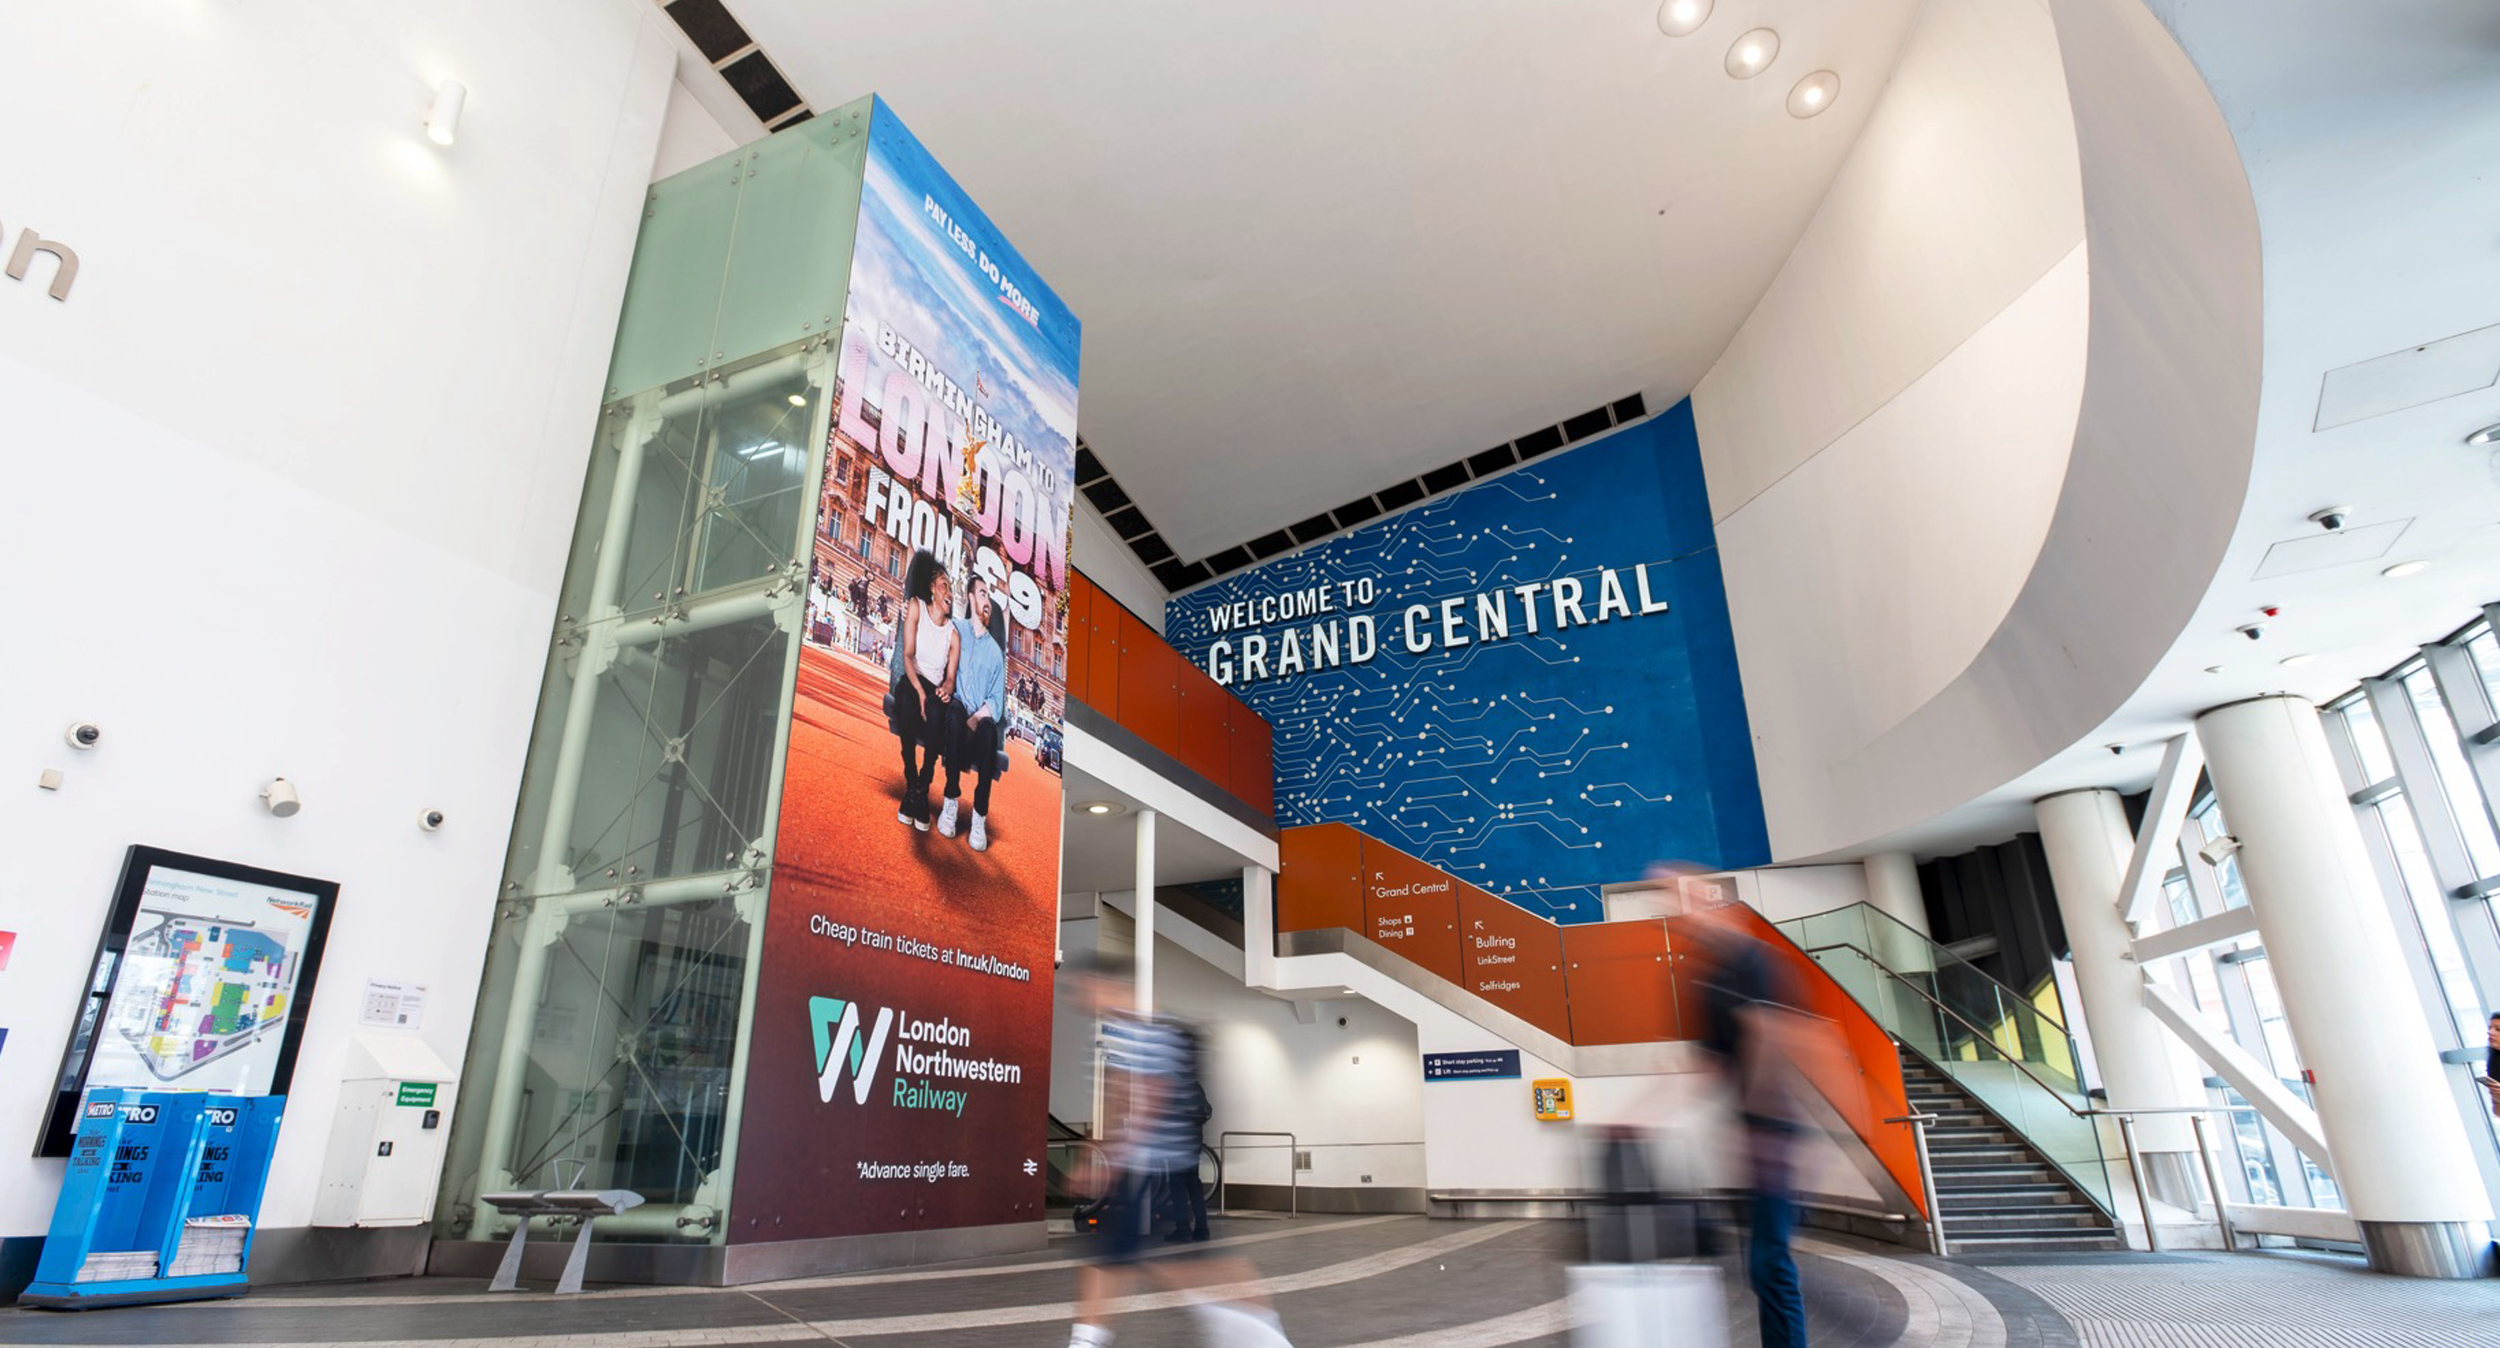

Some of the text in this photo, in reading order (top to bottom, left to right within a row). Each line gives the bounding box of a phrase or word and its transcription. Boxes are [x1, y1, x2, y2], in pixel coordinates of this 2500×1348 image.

[0, 218, 80, 302] n
[924, 194, 1040, 328] PAY LESS. DO MORE
[878, 321, 1056, 493] BIRMINGHAM TO
[840, 340, 1069, 590] LONDON
[864, 464, 1043, 631] FROM £9
[1209, 576, 1375, 634] WELCOME TO
[1208, 562, 1670, 687] GRAND CENTRAL
[171, 893, 190, 902] map
[196, 884, 214, 895] New
[216, 887, 239, 898] Street
[1376, 880, 1450, 899] Grand Central
[1378, 916, 1402, 928] Shops
[1378, 927, 1404, 939] Dining
[1476, 936, 1516, 949] Bullring
[810, 914, 1030, 981] Cheap train tickets at lnr.uk/london
[1479, 980, 1521, 992] Selfridges
[899, 1010, 970, 1047] London
[896, 1044, 1021, 1084] Northwestern
[400, 1095, 432, 1104] Equipment
[402, 1086, 434, 1095] Emergency
[893, 1077, 967, 1118] Railway
[88, 1103, 115, 1116] METRO
[118, 1107, 156, 1121] TRO
[202, 1146, 230, 1160] INGS
[109, 1171, 143, 1184] KING
[913, 1160, 945, 1183] single
[948, 1160, 970, 1178] fare.
